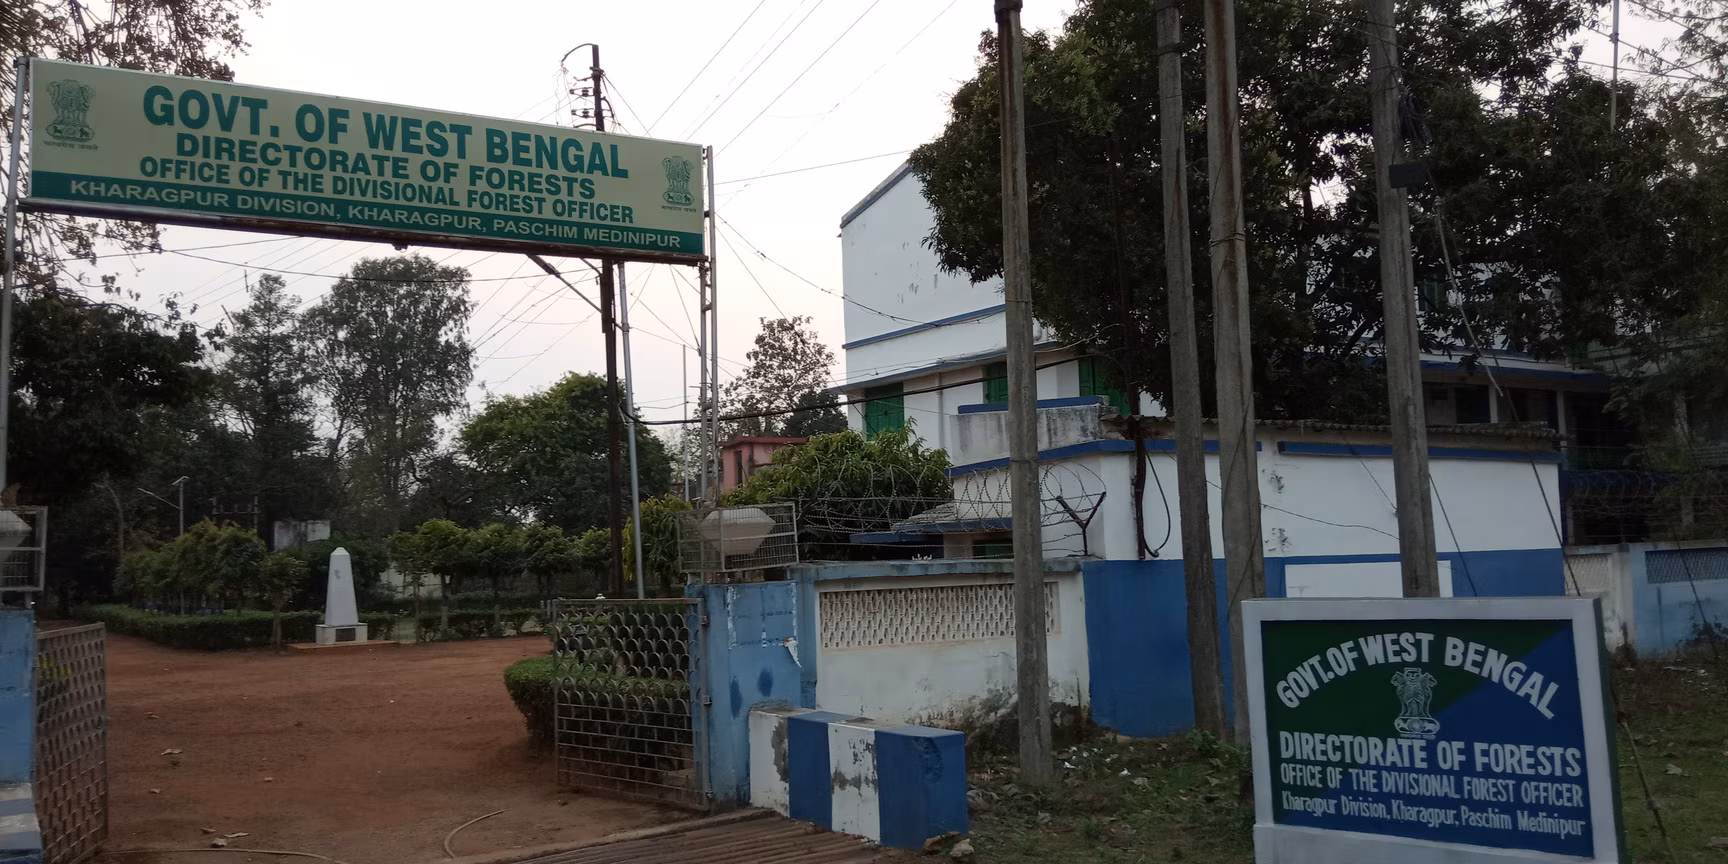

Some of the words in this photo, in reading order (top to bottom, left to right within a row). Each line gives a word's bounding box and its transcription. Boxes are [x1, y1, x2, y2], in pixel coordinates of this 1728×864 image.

[143, 85, 280, 138] GOVT.
[295, 103, 350, 145] OF
[362, 111, 472, 160] WEST
[485, 127, 629, 179] BENGAL
[176, 132, 410, 179] DIRECTORATE
[420, 160, 460, 185] OF
[469, 165, 596, 200] FORESTS
[70, 180, 231, 208] KHARAGPUR
[237, 195, 341, 220] DIVISION,
[348, 205, 488, 234] KHARAGPUR,
[493, 219, 579, 239] PASCHIM
[583, 227, 682, 249] MEDINIPUR
[139, 156, 231, 184] OFFICE
[239, 165, 272, 188] OF
[278, 169, 325, 194] THE
[332, 174, 460, 207] DIVISIONAL
[467, 190, 546, 216] FOREST
[552, 199, 635, 224] OFFICER
[1358, 632, 1434, 666] WEST
[1444, 636, 1560, 720] BENGAL
[1279, 731, 1428, 769] DIRECTORATE
[1437, 741, 1467, 771] OF
[1474, 742, 1582, 777] FORESTS
[1280, 763, 1323, 787] OFFICE
[1327, 767, 1344, 789] OF
[1351, 768, 1379, 793] THE
[1382, 770, 1461, 799] DIVISIONAL
[1464, 779, 1515, 804] FOREST
[1520, 784, 1584, 808] OFFICER
[1282, 791, 1337, 817] Kharagpur
[1341, 795, 1391, 820] Division,
[1392, 801, 1459, 828] Kharagpur,
[1461, 808, 1512, 830] Paschim
[1517, 811, 1586, 839] Medinipur
